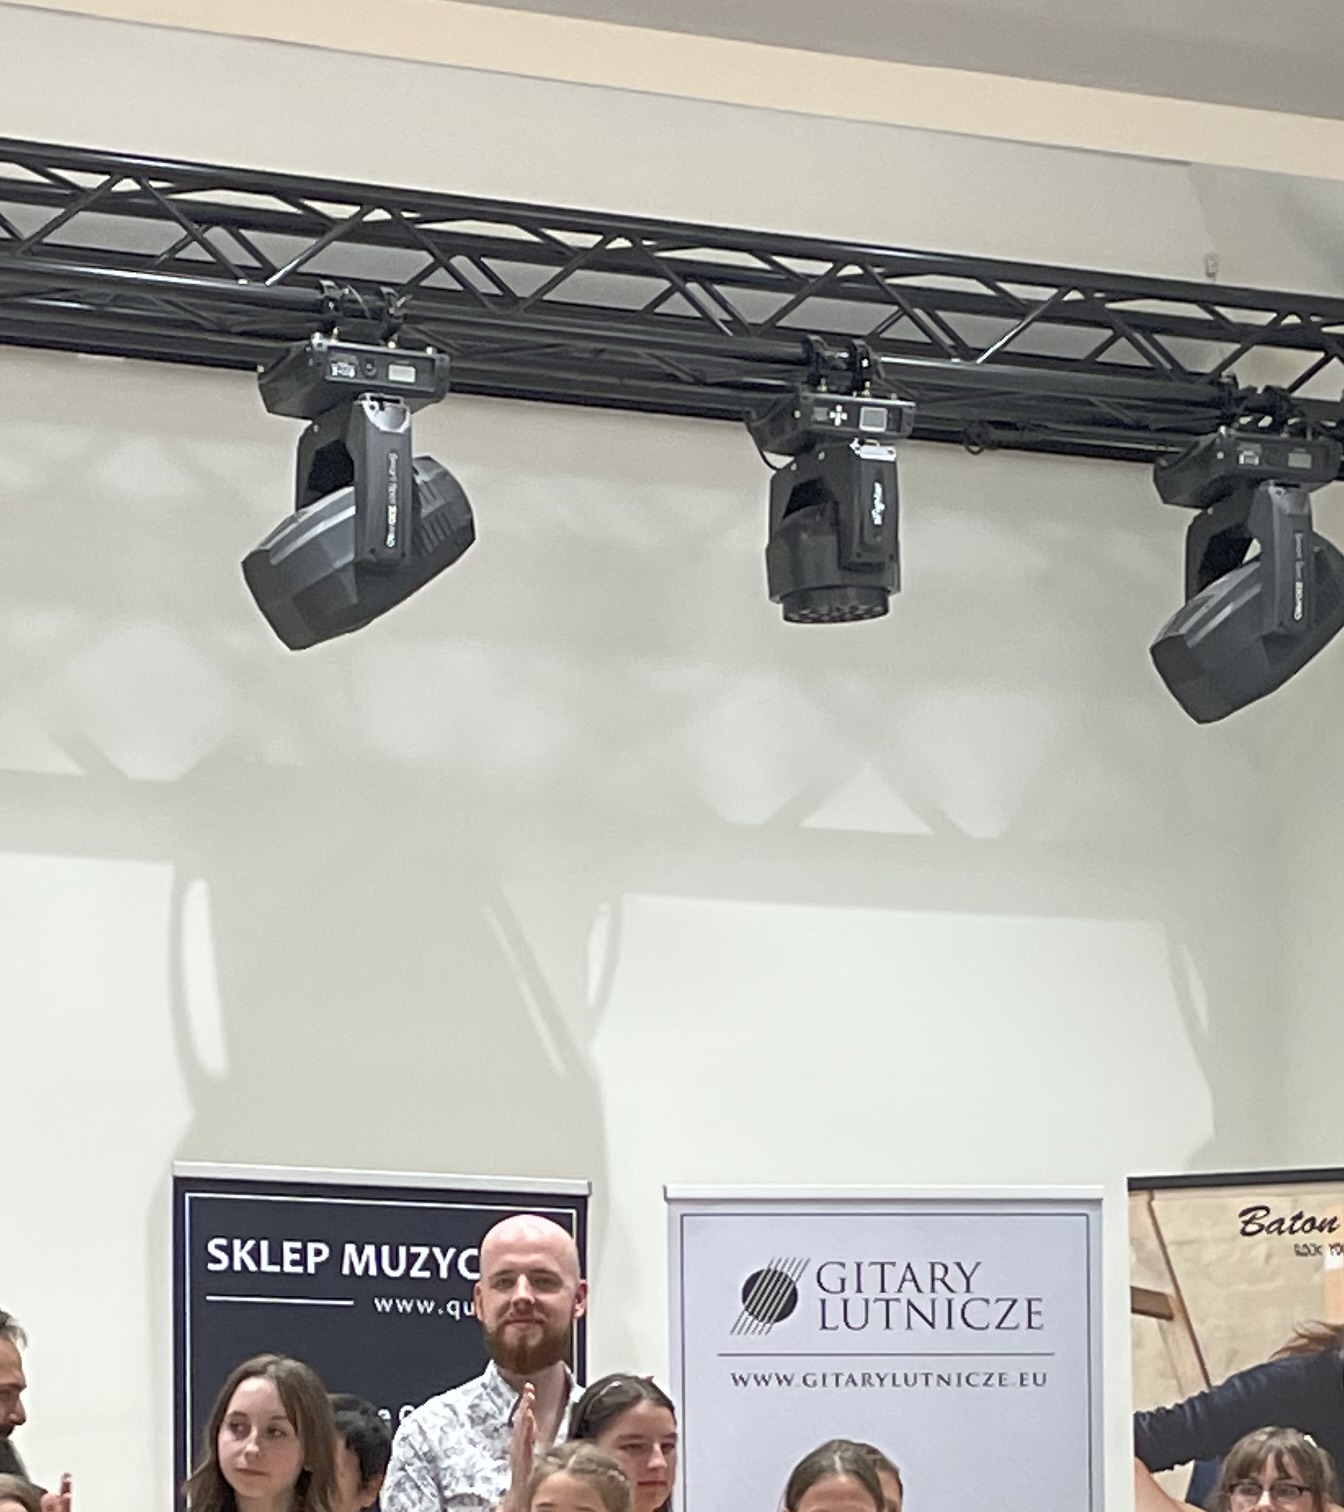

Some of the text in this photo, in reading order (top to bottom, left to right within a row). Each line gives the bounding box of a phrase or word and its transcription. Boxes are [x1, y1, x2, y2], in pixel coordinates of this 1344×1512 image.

[1238, 1204, 1340, 1237] Baton
[207, 1237, 480, 1280] SKLEP MUZYC
[816, 1260, 982, 1294] GITARY
[373, 1296, 477, 1319] www.qu
[818, 1297, 1045, 1330] LUTNICZE
[730, 1371, 1048, 1389] WWW.GITARYLUTNICZE.EU
